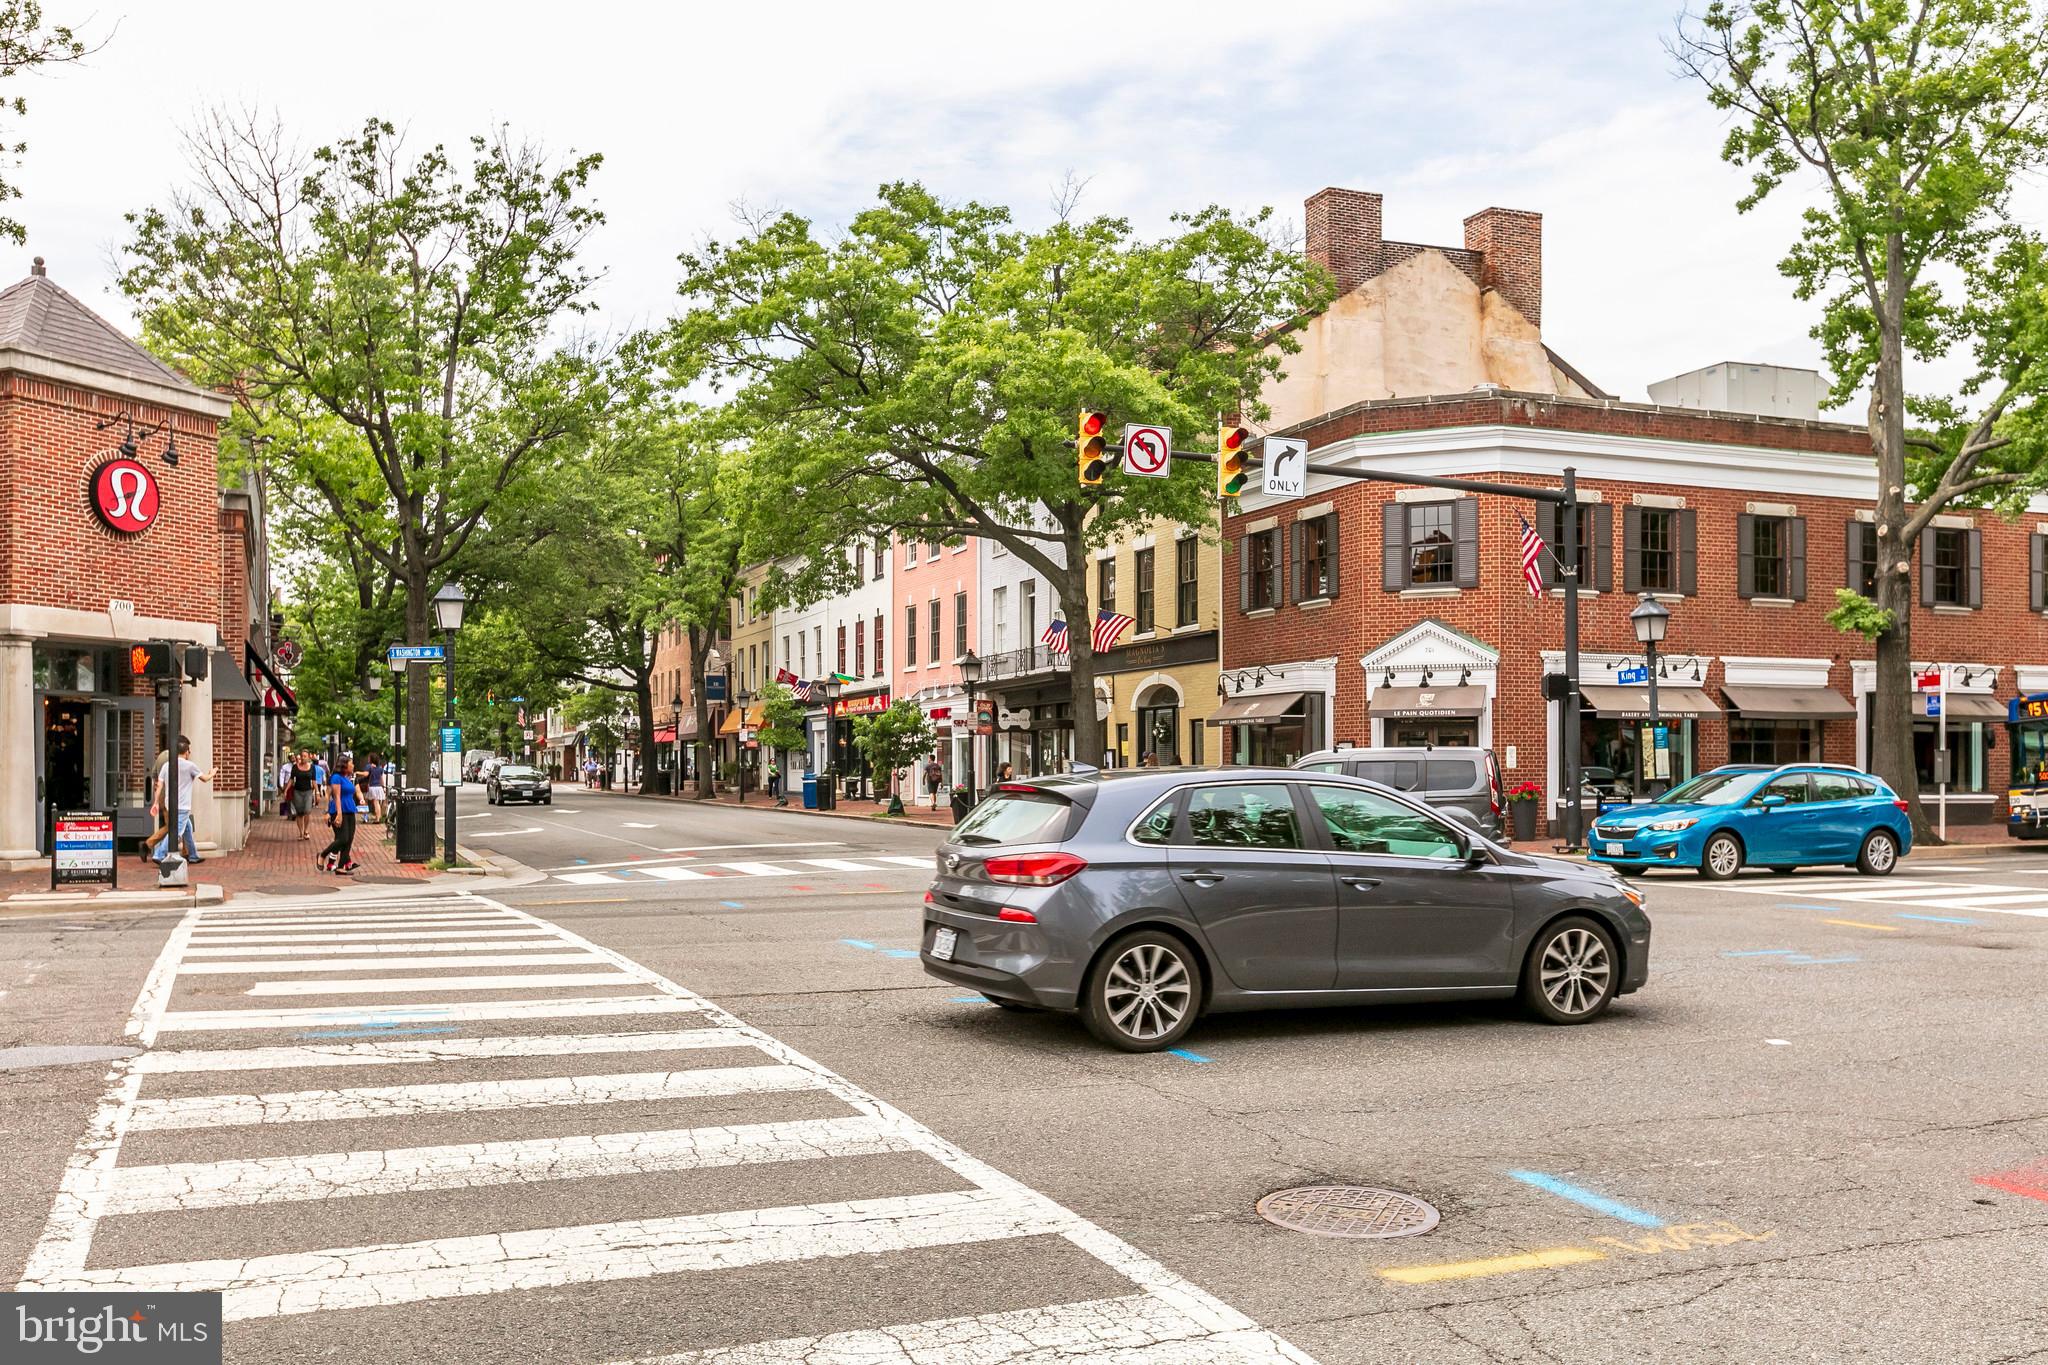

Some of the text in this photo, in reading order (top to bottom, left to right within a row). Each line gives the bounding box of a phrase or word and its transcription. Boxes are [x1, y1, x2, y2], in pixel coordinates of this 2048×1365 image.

[1270, 480, 1299, 492] ONLY
[114, 600, 132, 610] 700
[396, 648, 420, 657] WASHINGTON
[1620, 671, 1636, 682] King
